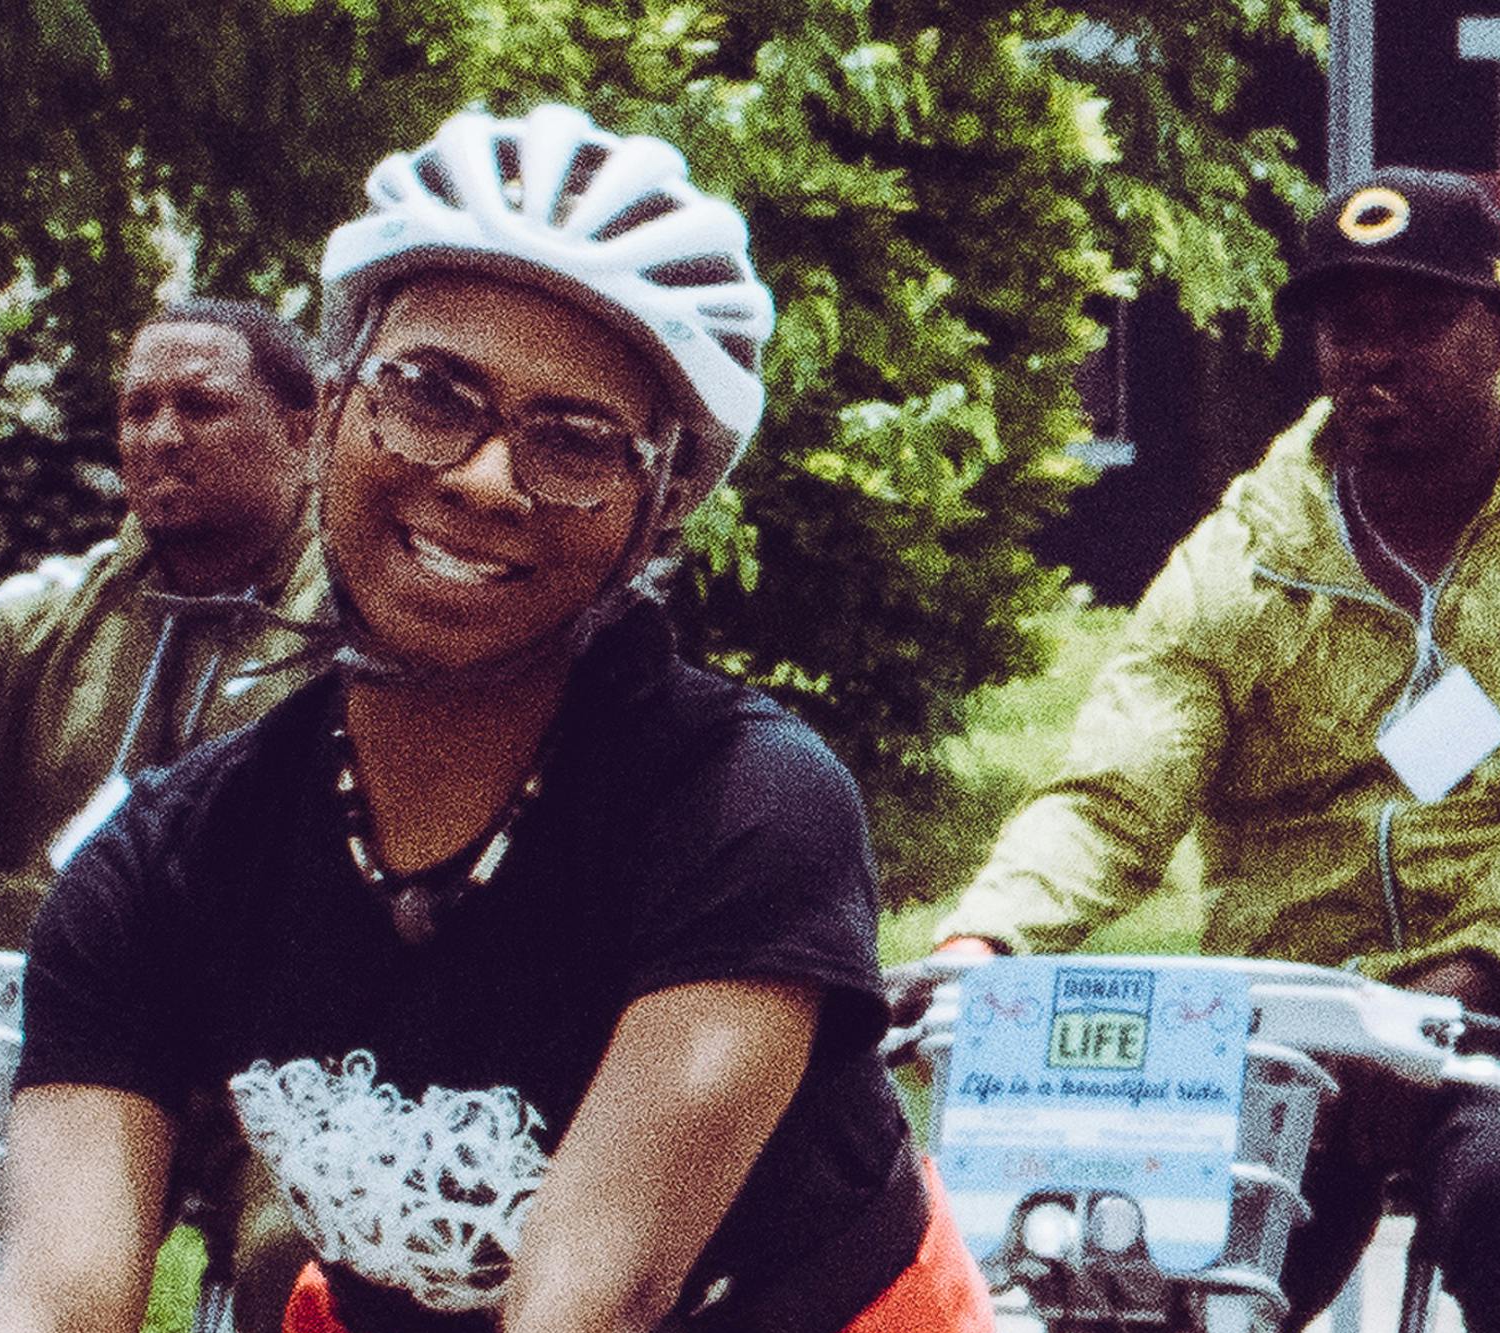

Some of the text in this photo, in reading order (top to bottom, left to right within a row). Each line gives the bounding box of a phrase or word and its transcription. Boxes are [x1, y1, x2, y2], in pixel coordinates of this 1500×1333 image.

[1062, 976, 1143, 1001] DONATE
[1057, 1021, 1140, 1062] LIFE
[959, 1072, 1002, 1104] Life
[1009, 1075, 1030, 1096] is
[1038, 1081, 1052, 1097] a
[1060, 1077, 1169, 1108] beautiful
